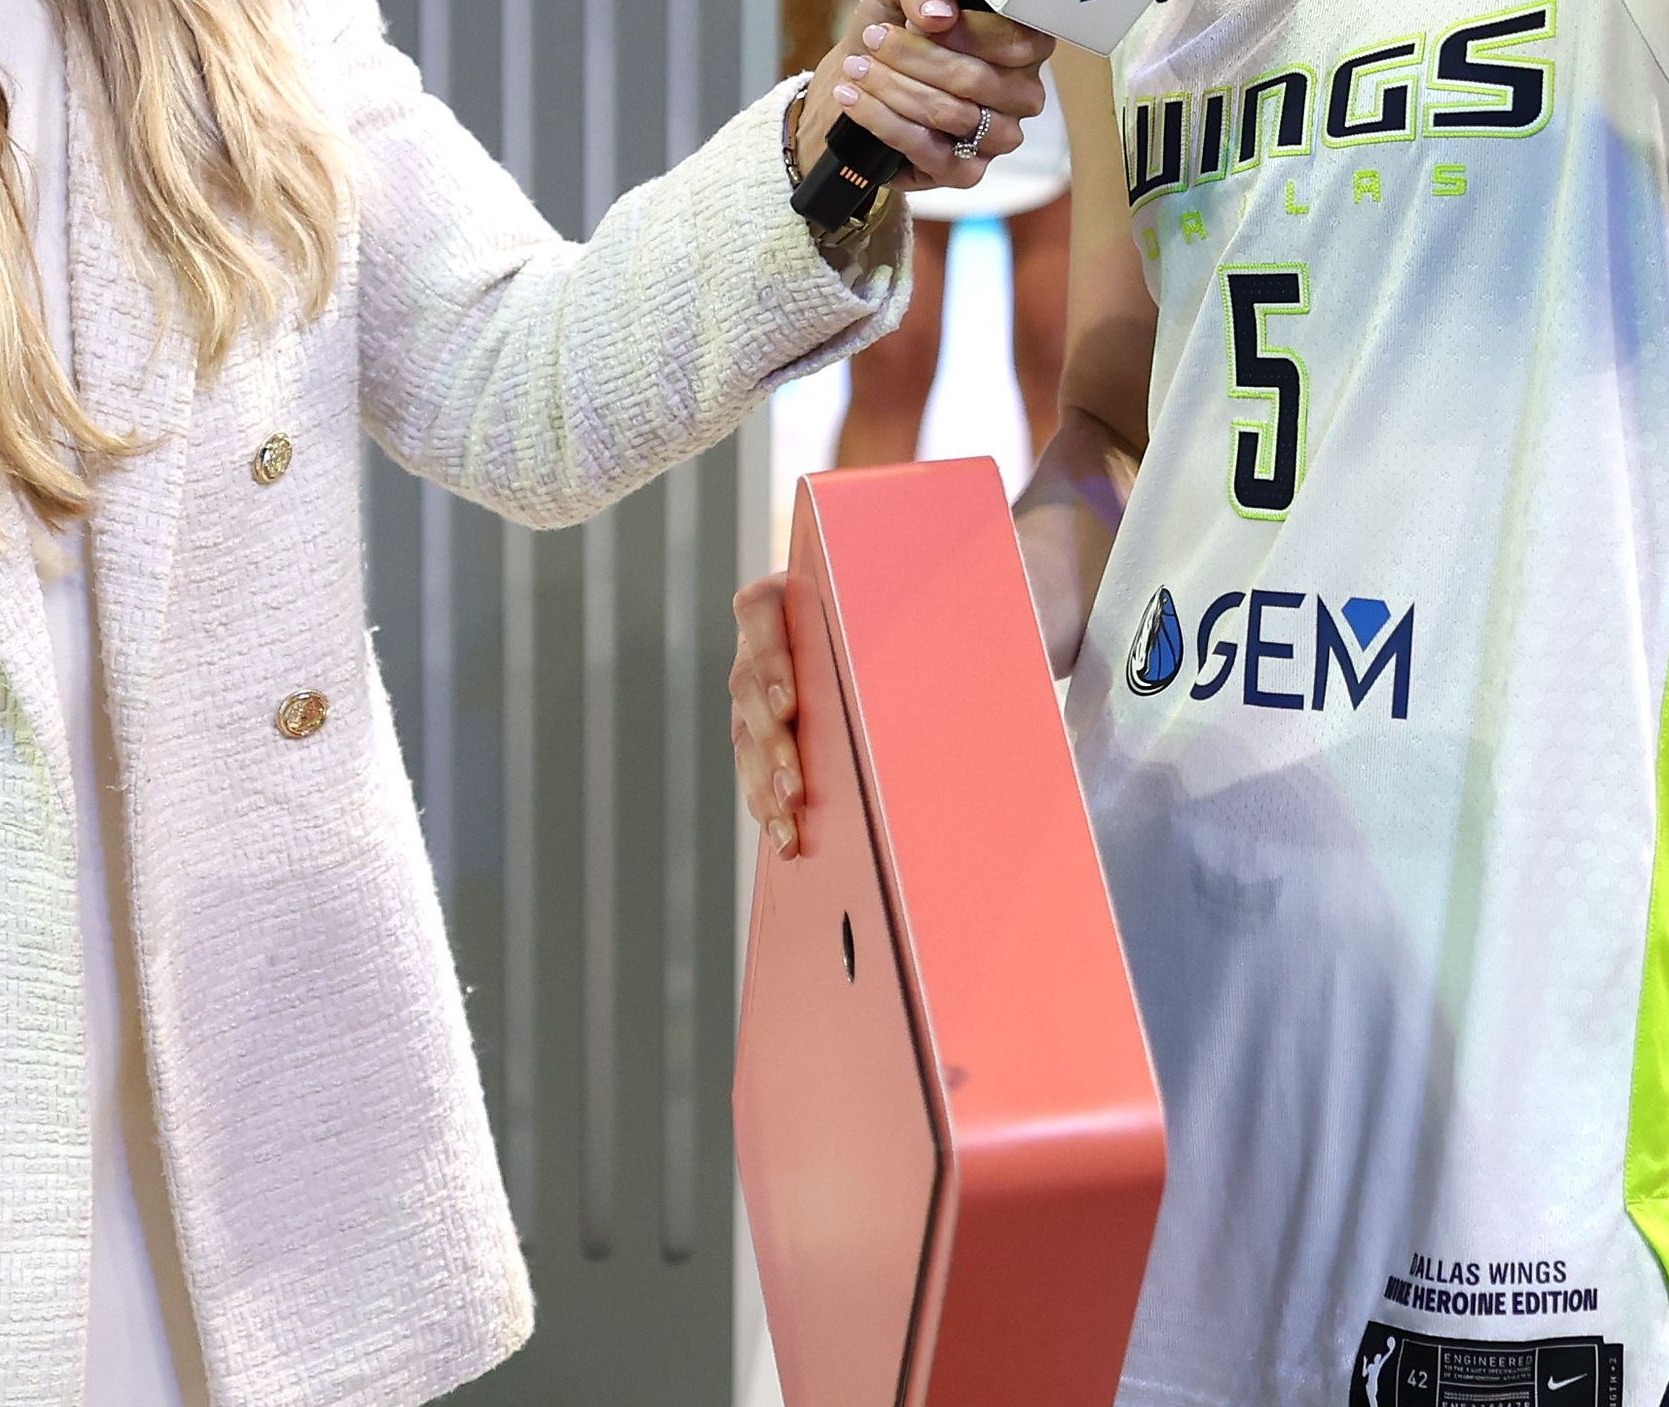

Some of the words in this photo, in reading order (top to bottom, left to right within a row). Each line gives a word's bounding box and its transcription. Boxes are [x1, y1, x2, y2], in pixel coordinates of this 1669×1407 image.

[1142, 162, 1468, 260] DALAS
[1218, 262, 1311, 522] 5
[1189, 589, 1416, 720] GEM
[1409, 1253, 1480, 1285] DALLAS
[1489, 1260, 1567, 1285] WINGS
[1413, 1284, 1506, 1315] HEROINE
[1512, 1288, 1598, 1315] EDITION
[1443, 1353, 1533, 1367] ENGINEERED
[1407, 1369, 1428, 1389] 42
